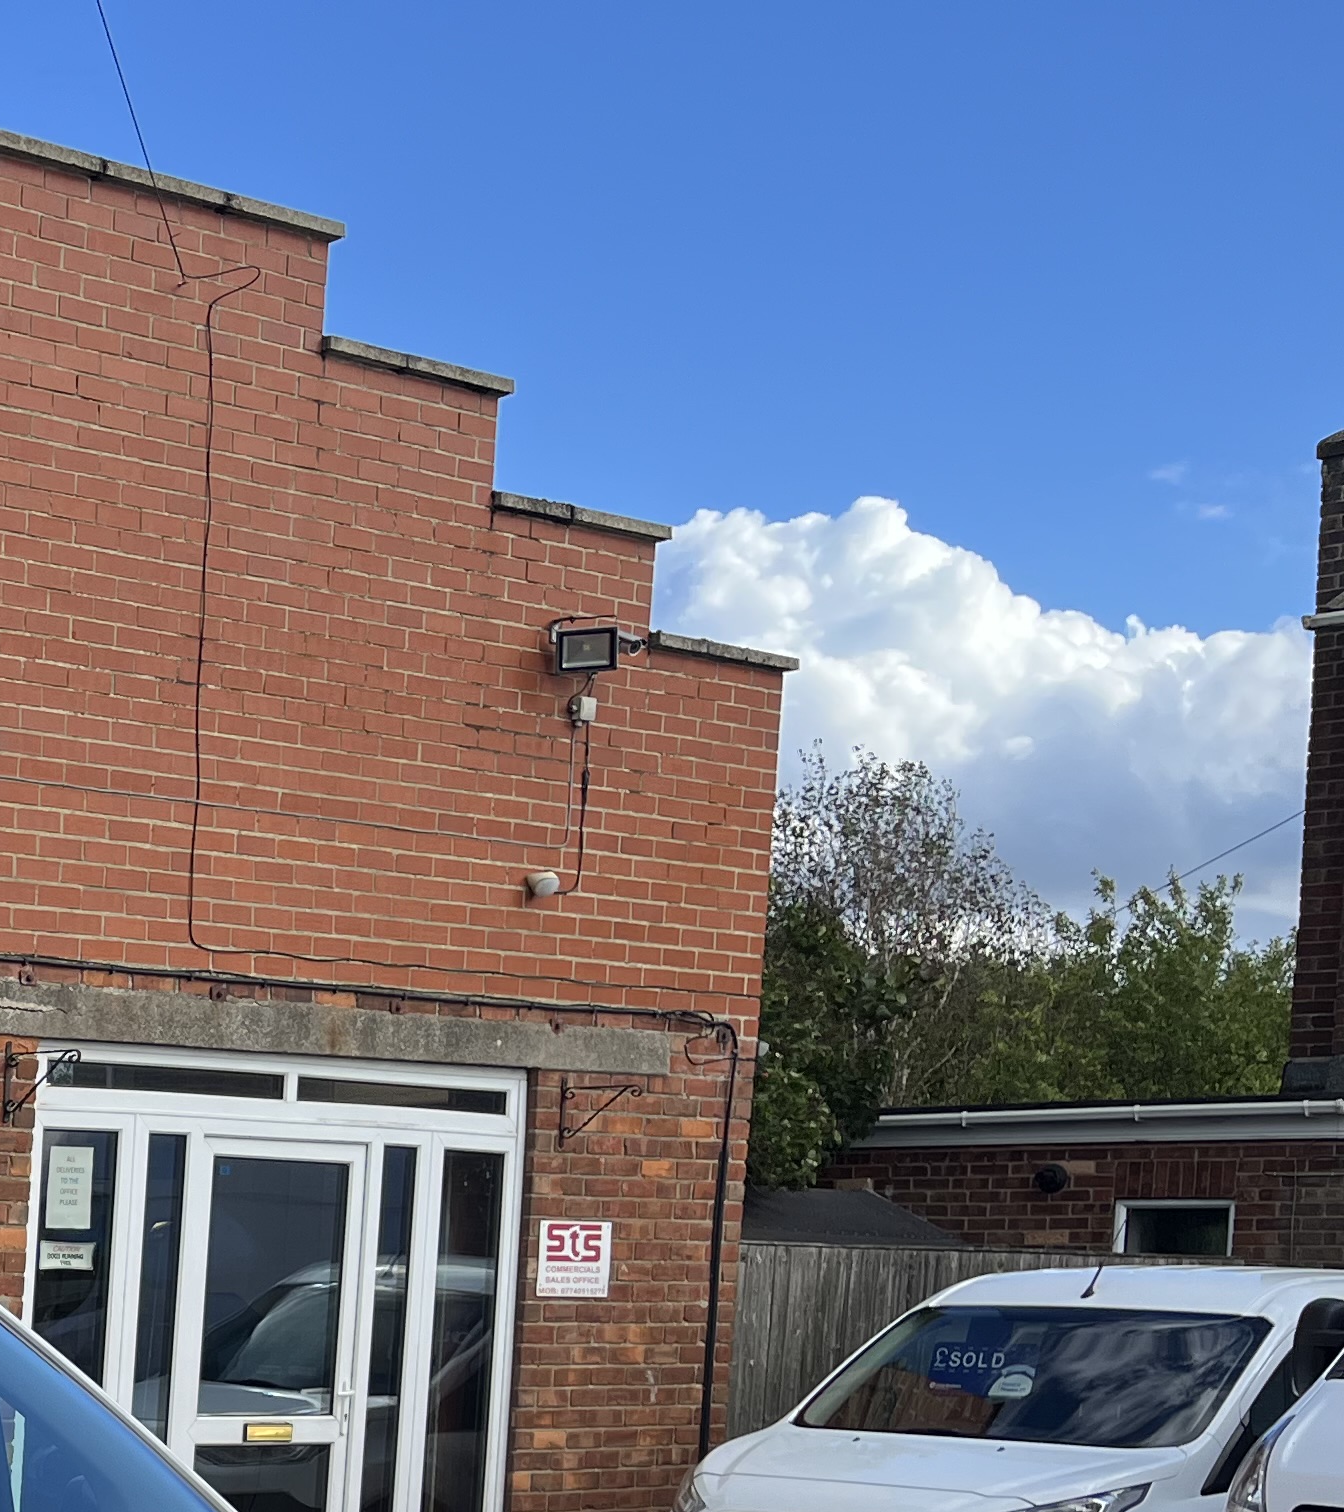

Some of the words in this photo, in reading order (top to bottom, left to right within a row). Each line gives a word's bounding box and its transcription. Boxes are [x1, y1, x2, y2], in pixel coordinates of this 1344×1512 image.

[66, 1155, 76, 1163] ALL
[56, 1166, 85, 1174] DELIVERIES
[69, 1177, 80, 1185] THE
[545, 1265, 601, 1274] COMMERCIALS
[545, 1276, 571, 1284] SALES
[572, 1276, 600, 1284] OFFICE
